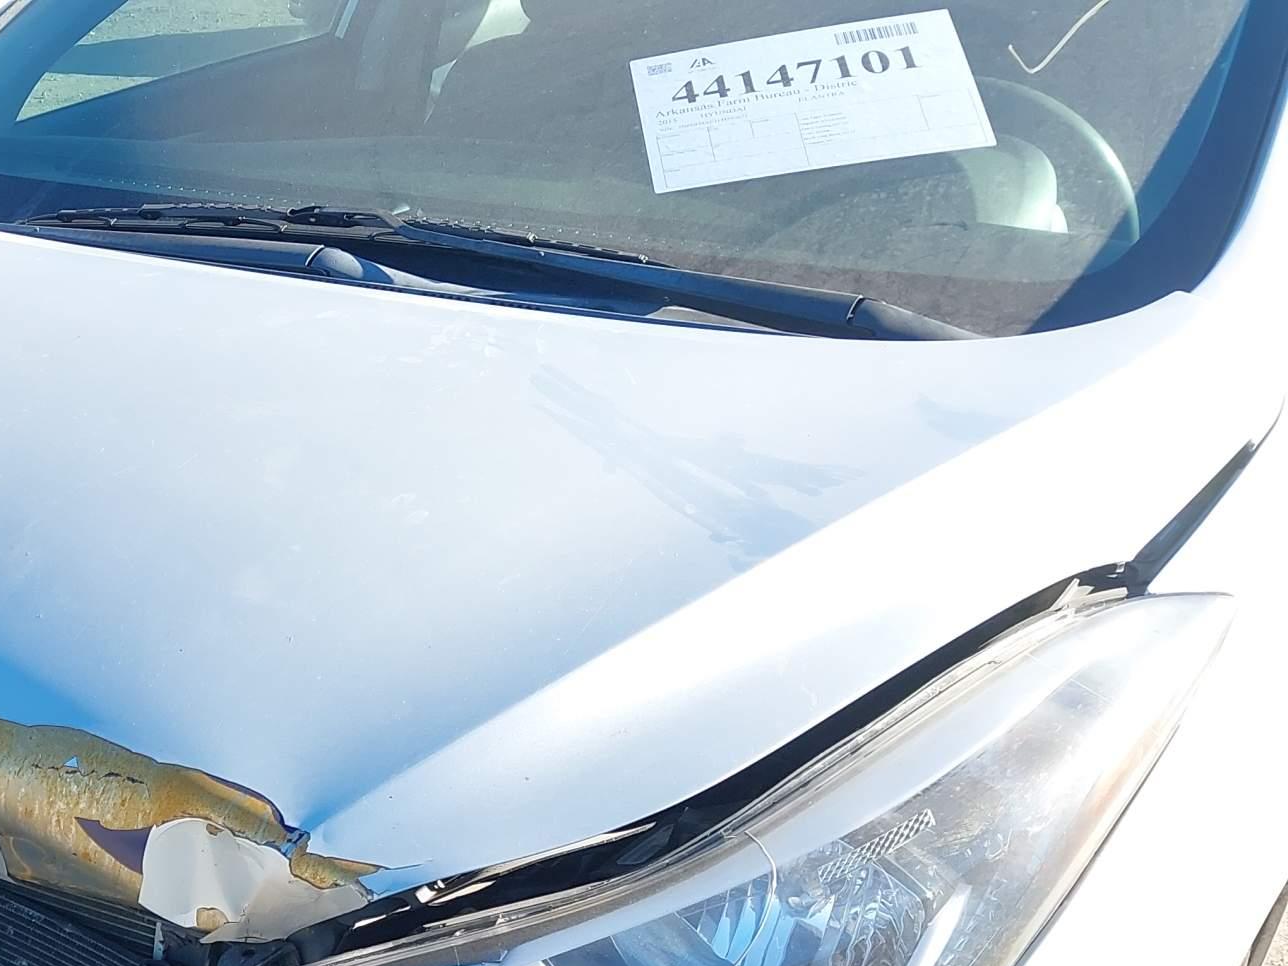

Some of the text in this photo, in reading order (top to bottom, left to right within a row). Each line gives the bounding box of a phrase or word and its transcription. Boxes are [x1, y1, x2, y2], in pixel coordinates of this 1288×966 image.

[671, 46, 924, 104] 44147101
[655, 104, 714, 119] Arkansas
[717, 97, 750, 108] Farm
[754, 90, 801, 102] Bureau
